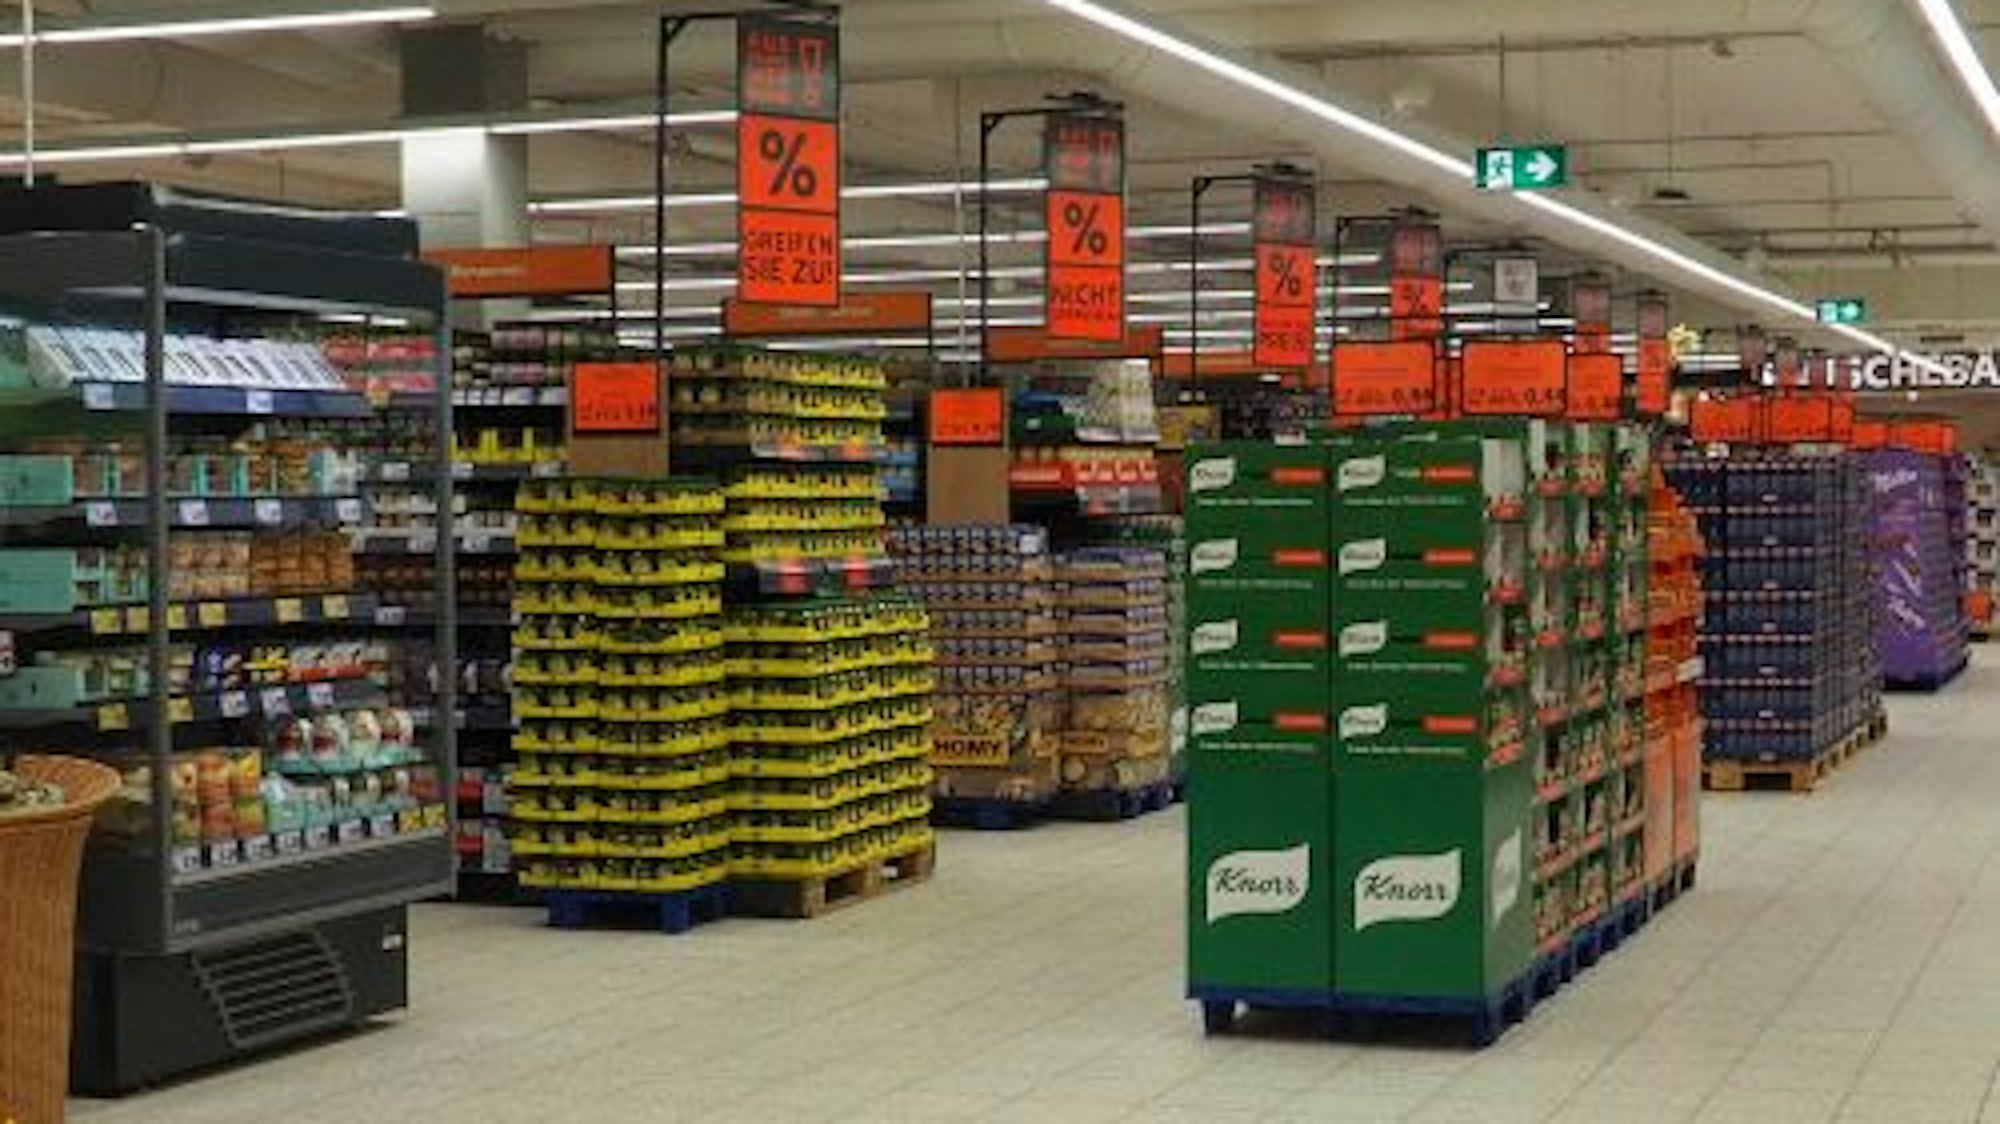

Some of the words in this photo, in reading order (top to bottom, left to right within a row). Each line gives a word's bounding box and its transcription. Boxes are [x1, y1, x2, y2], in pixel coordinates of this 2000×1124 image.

[759, 128, 817, 198] %
[1064, 202, 1107, 255] %
[1268, 252, 1302, 297] %
[933, 740, 999, 755] HOMY
[1215, 867, 1301, 896] Knorr
[1363, 873, 1448, 902] Knorr
